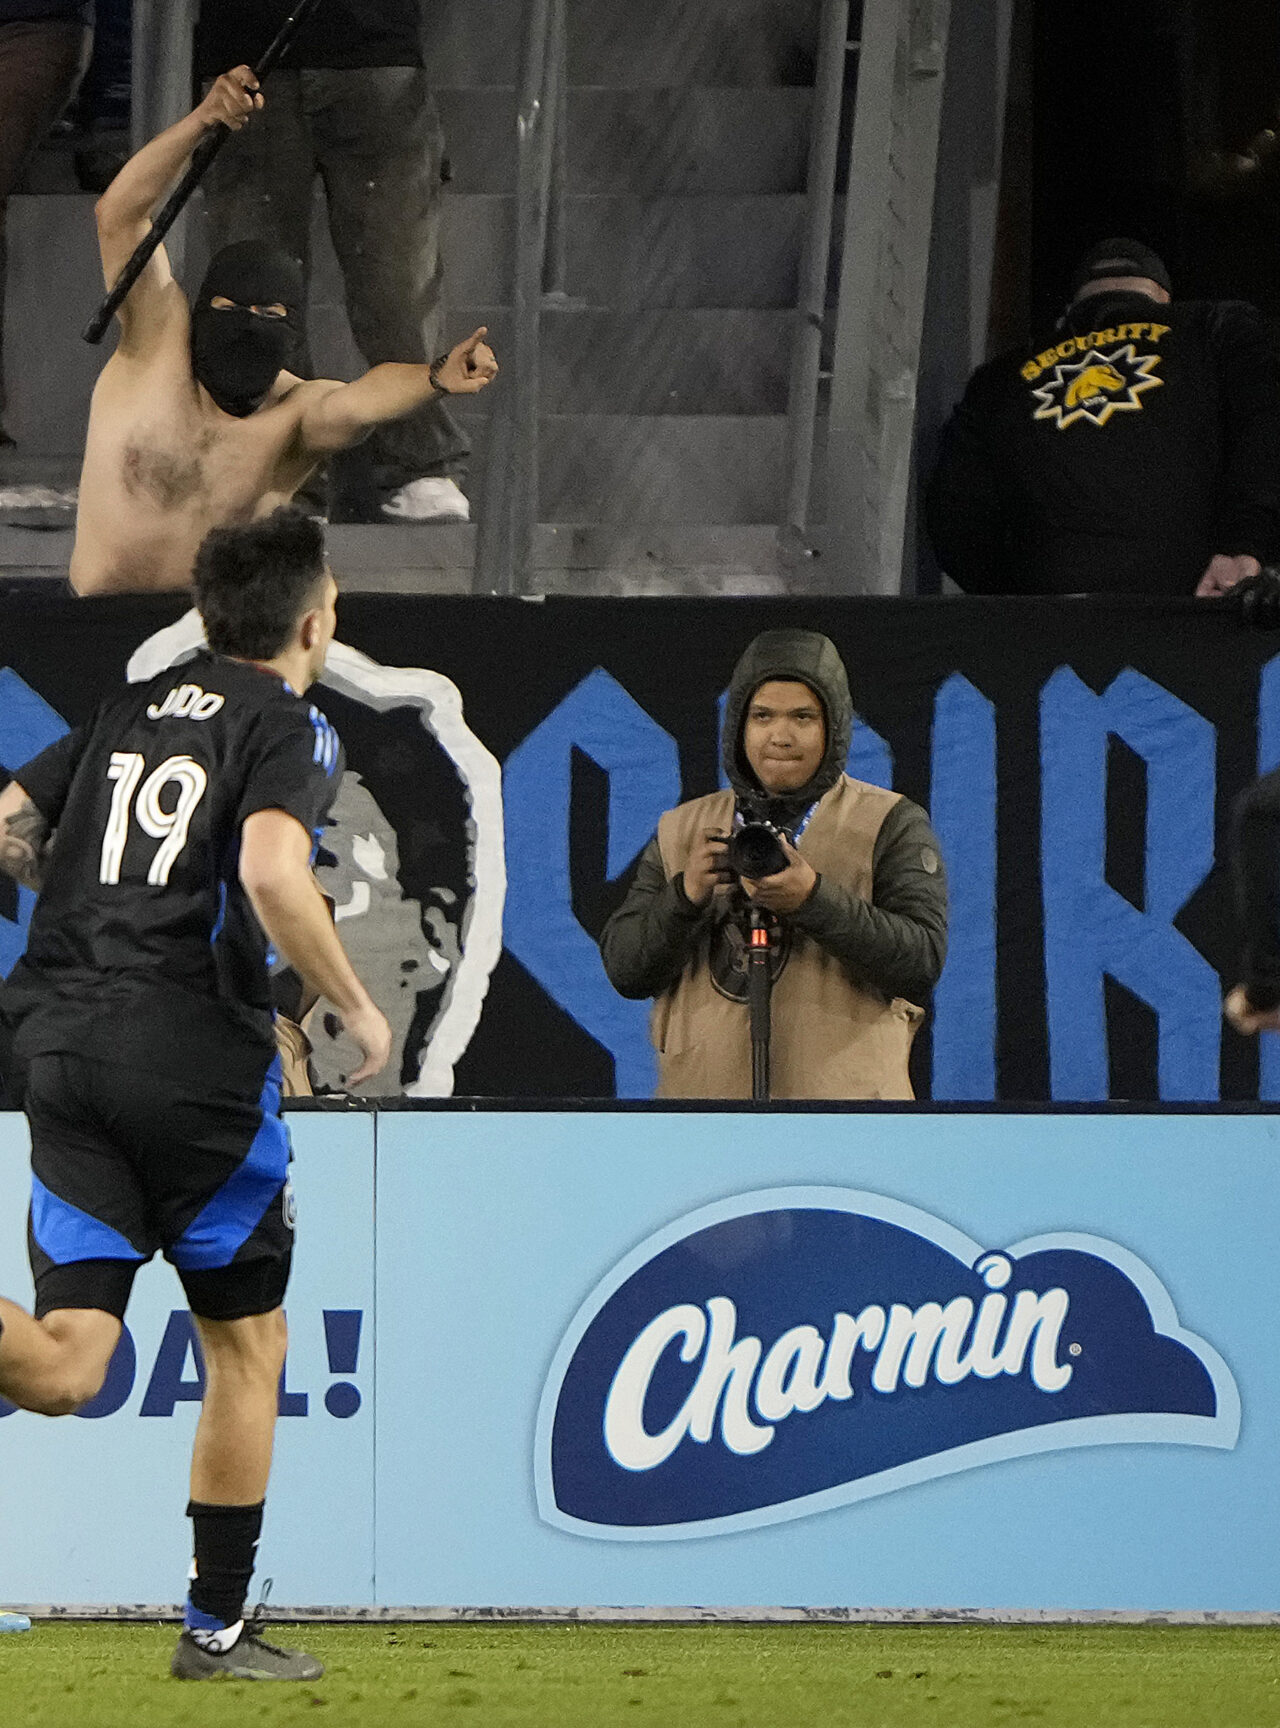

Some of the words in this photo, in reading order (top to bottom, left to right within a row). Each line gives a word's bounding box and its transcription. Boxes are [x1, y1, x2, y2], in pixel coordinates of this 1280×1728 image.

[1021, 323, 1171, 381] SECURITY
[100, 751, 208, 886] 19
[604, 1254, 1072, 1471] Charmin
